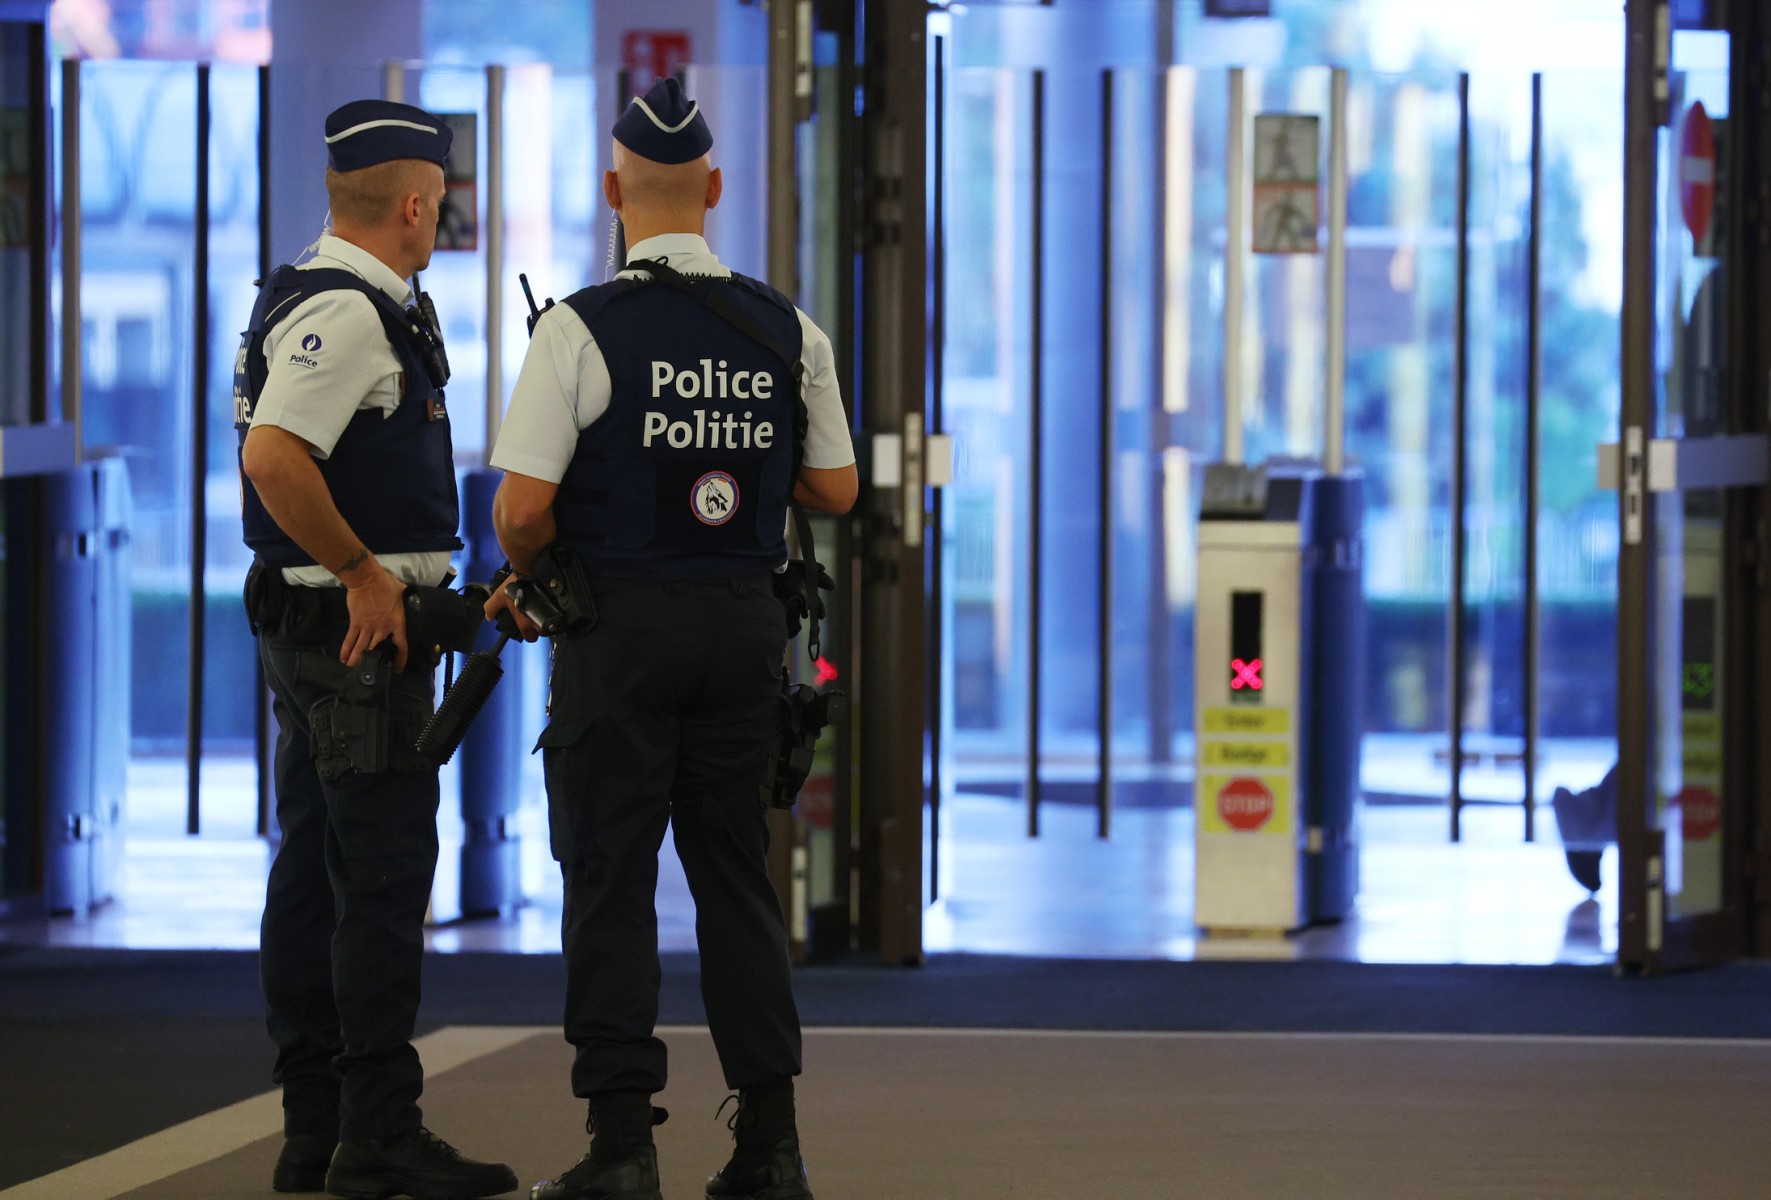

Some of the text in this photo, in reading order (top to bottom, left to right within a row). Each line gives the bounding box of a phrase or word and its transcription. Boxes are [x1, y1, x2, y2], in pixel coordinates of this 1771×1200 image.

[290, 354, 318, 368] Police
[651, 358, 773, 399] Police
[643, 409, 774, 449] Politie
[1223, 794, 1267, 815] STOP
